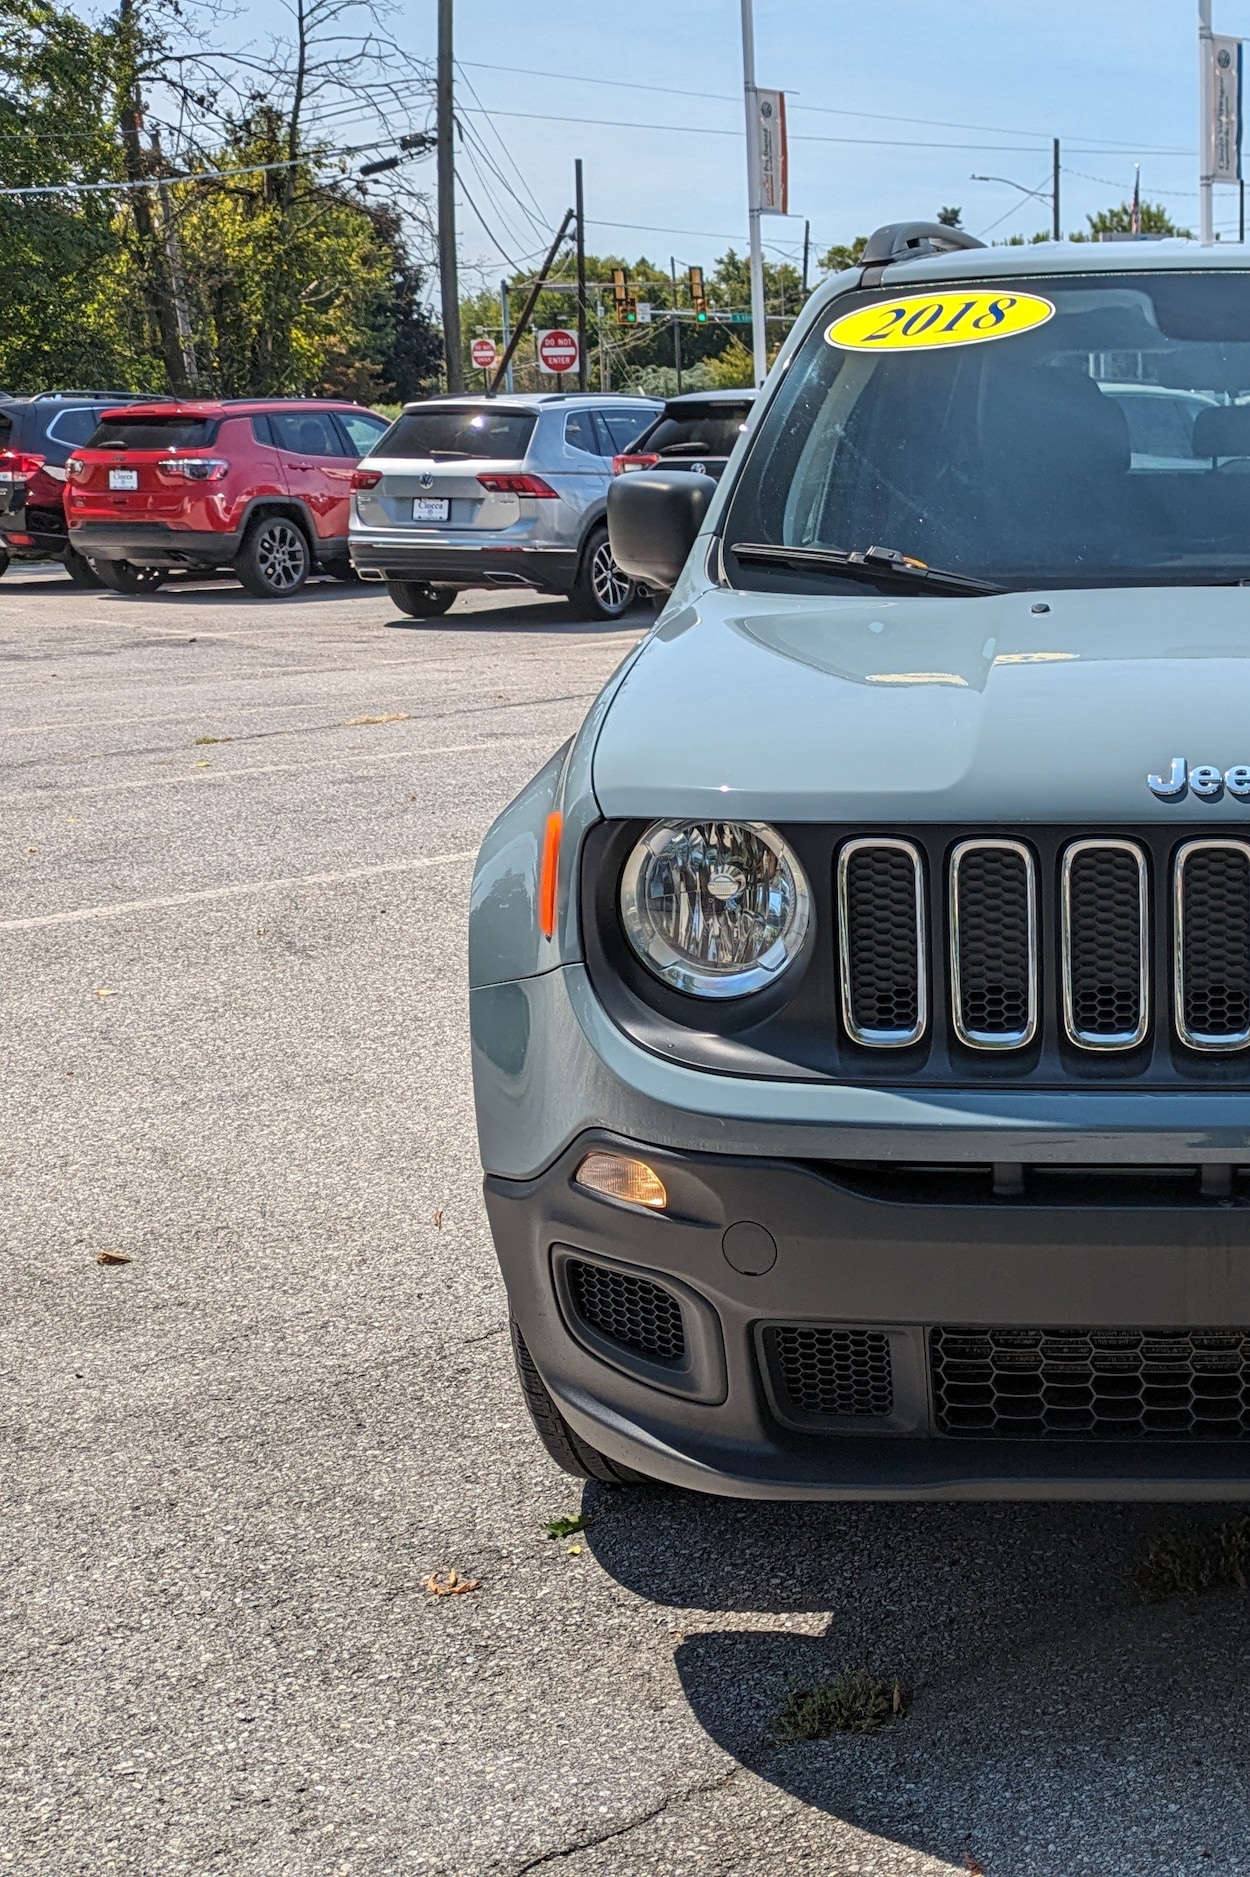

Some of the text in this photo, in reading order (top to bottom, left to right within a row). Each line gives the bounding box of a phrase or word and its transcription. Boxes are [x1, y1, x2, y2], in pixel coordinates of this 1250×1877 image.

[860, 297, 1017, 342] 2018
[548, 356, 571, 365] ENTER
[418, 501, 443, 510] Ciocca
